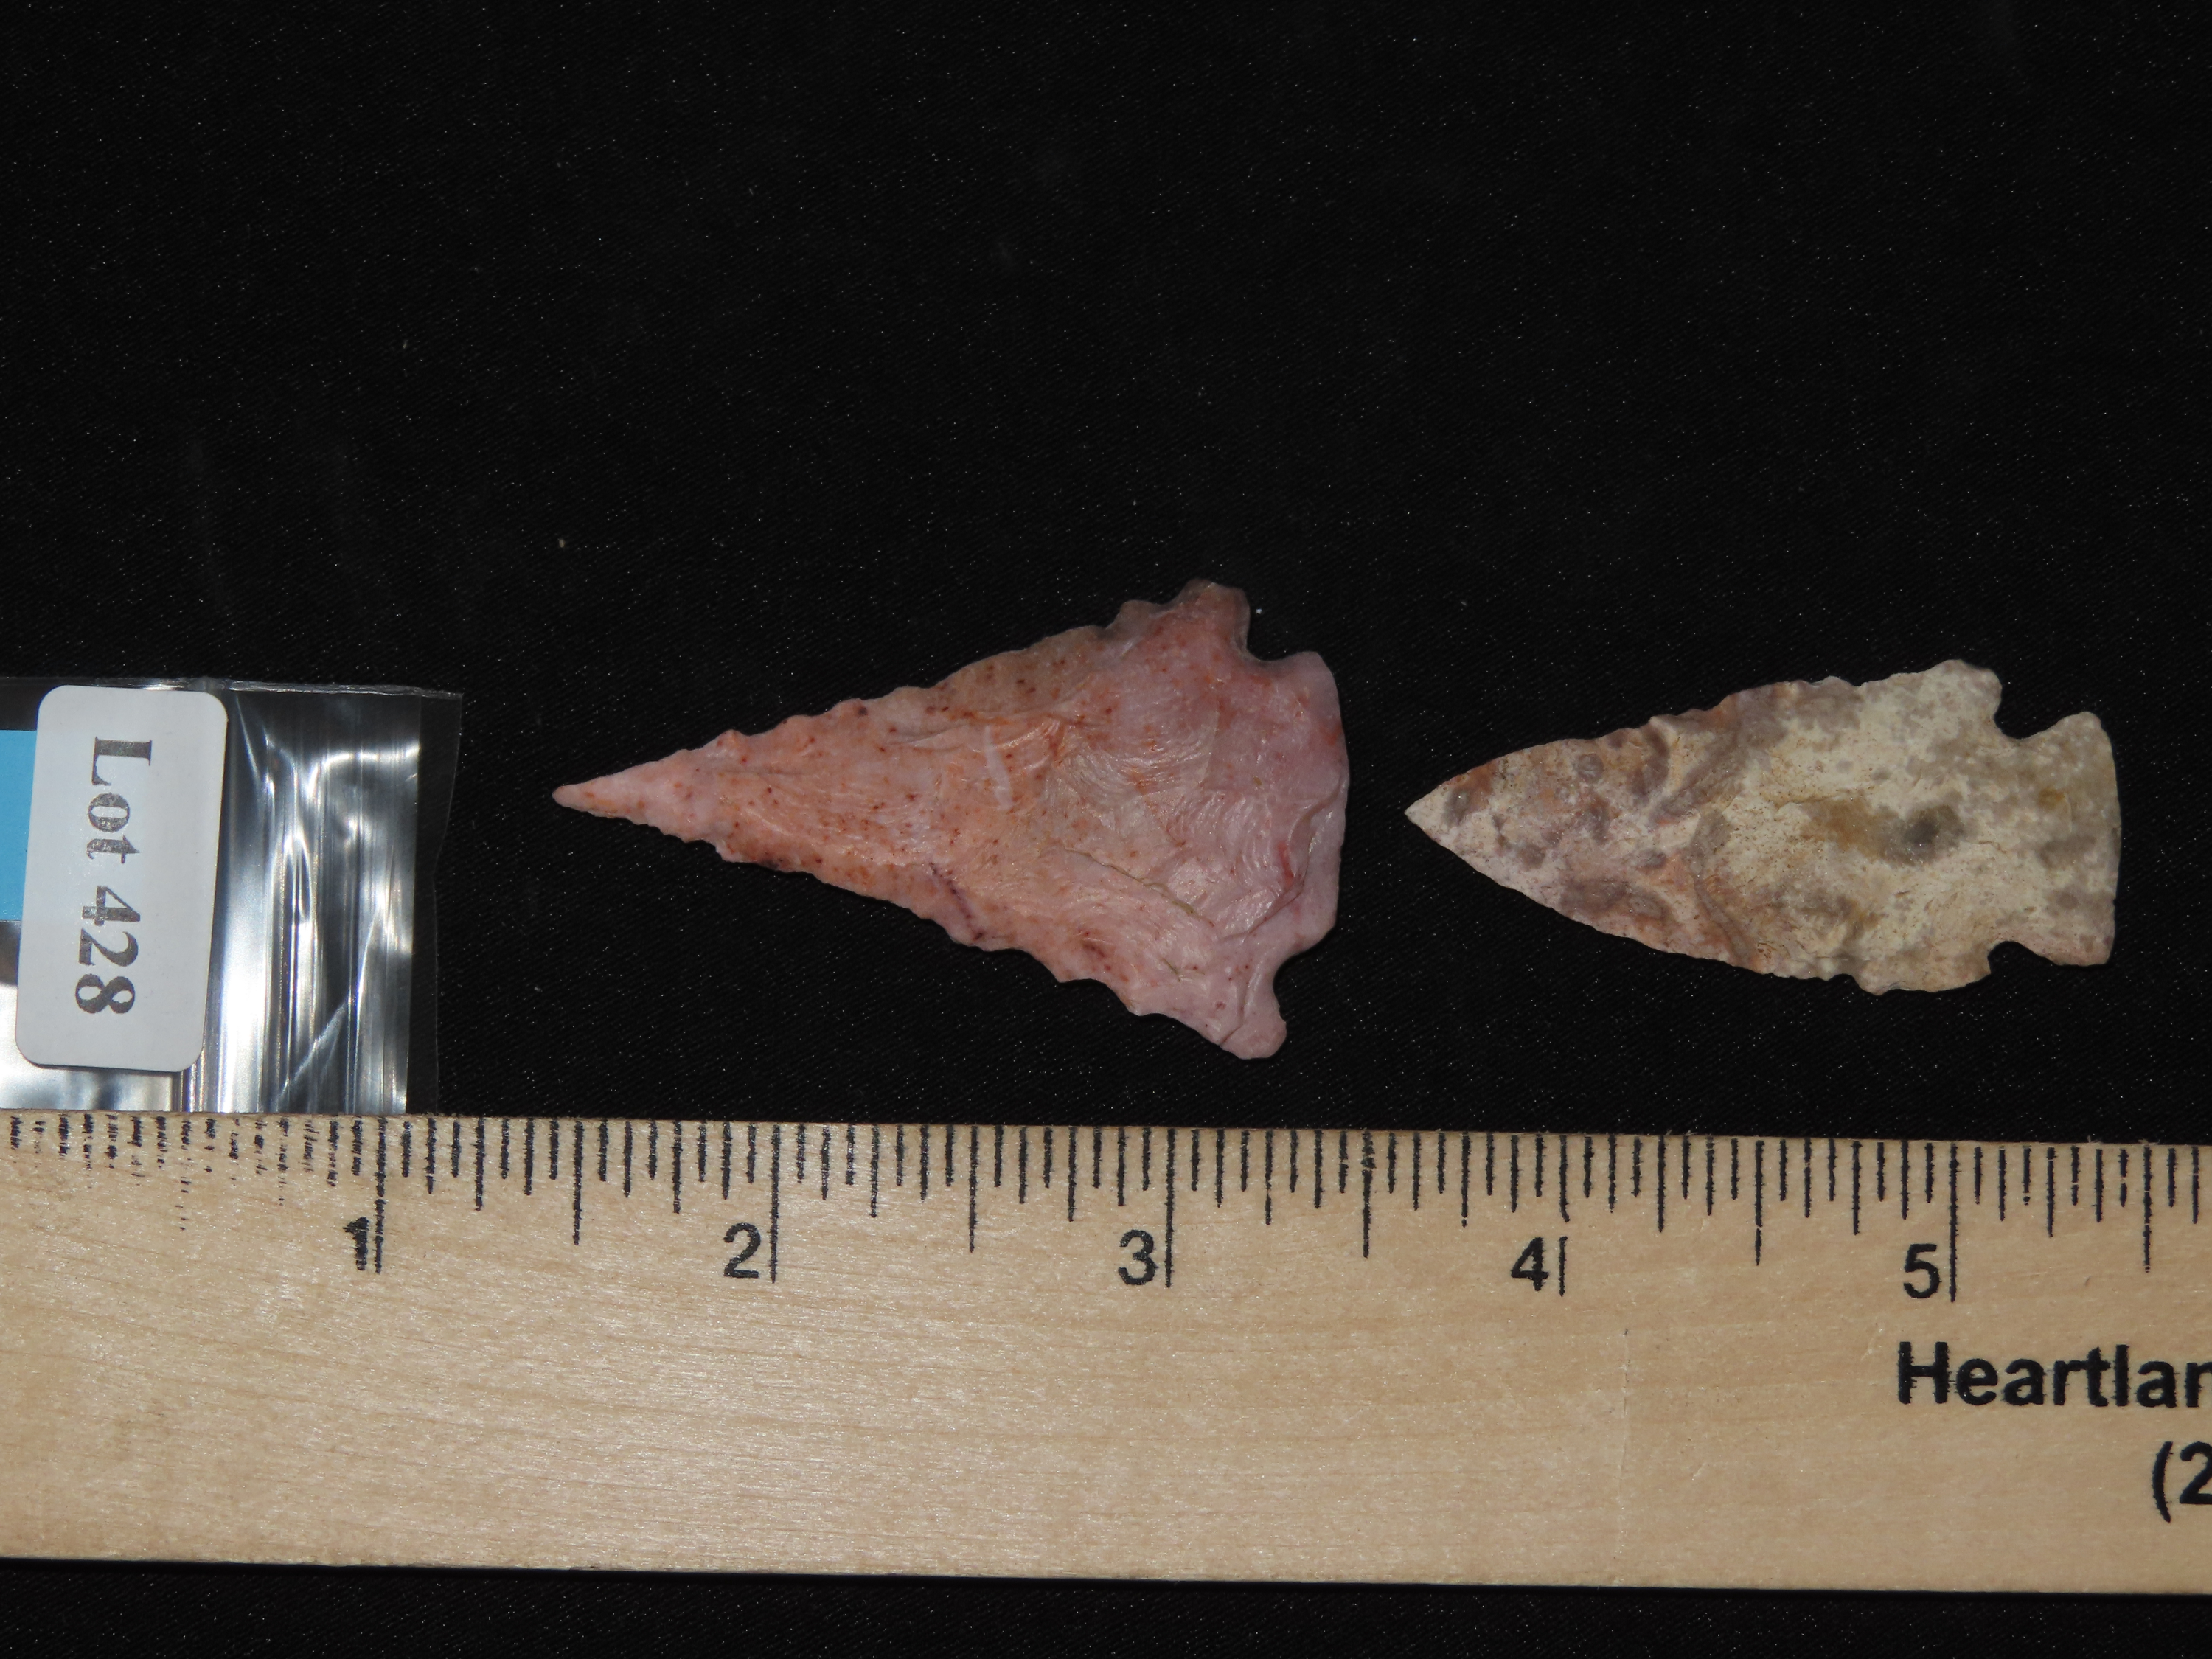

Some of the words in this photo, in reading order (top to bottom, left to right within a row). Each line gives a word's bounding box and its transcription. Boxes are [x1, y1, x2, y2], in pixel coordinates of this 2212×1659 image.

[86, 735, 153, 865] Lot
[74, 885, 142, 1015] 428
[342, 1216, 370, 1271] 1
[723, 1222, 762, 1279] 2
[1118, 1229, 1159, 1286] 3
[1510, 1237, 1550, 1292] 4
[1903, 1242, 1943, 1299] 5
